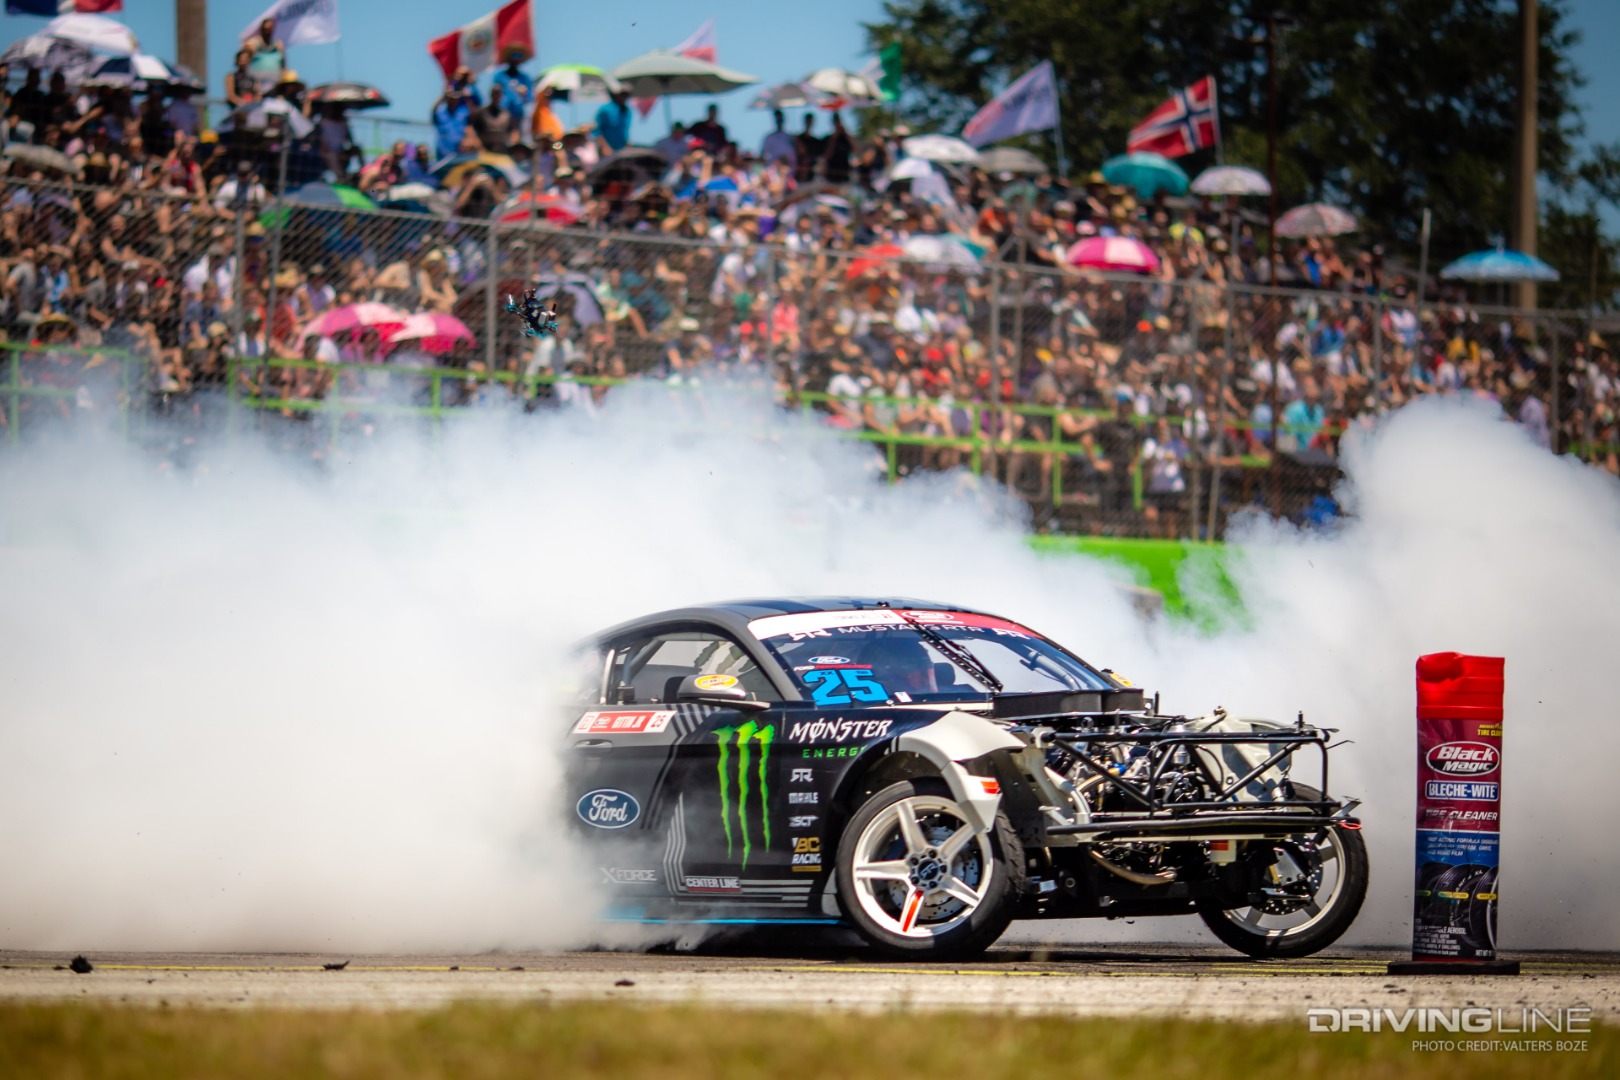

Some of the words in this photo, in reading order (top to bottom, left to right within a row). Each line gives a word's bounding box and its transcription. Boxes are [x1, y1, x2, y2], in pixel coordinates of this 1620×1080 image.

[803, 669, 889, 706] 25
[1437, 746, 1495, 762] Black
[1442, 761, 1493, 773] Magic
[1428, 783, 1496, 798] BLECHE-WITE
[588, 794, 628, 822] Ford
[1449, 810, 1498, 820] CLEANER
[791, 853, 822, 865] RACING
[685, 877, 719, 888] CENTER
[720, 878, 740, 888] LINE
